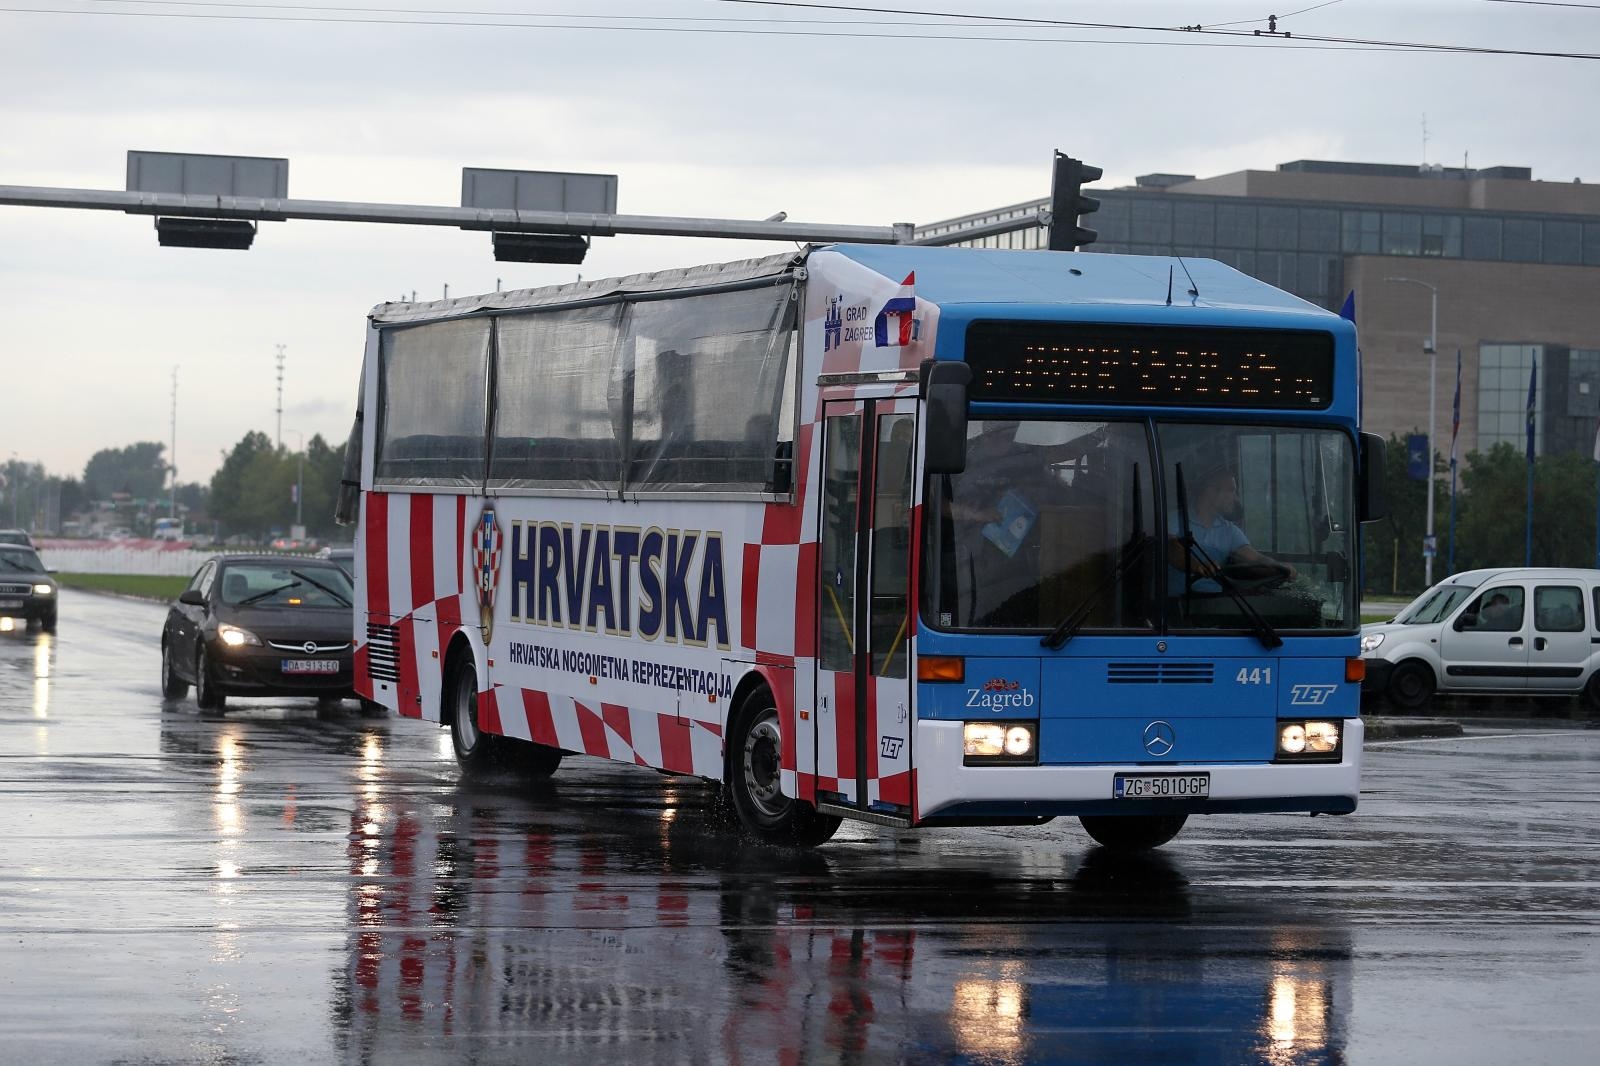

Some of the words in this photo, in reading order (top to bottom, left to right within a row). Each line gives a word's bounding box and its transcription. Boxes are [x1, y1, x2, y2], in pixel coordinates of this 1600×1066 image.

[846, 307, 867, 321] GRAD
[844, 327, 874, 342] ZAGREB
[511, 519, 731, 651] HRVATSKA
[509, 641, 560, 671] HRVATSKA
[562, 650, 630, 682] NOGOMETNA
[632, 662, 732, 700] REPREZENTACIJA
[1236, 667, 1271, 685] 441
[966, 687, 1034, 712] Zagreb
[1291, 684, 1338, 705] ZET
[880, 735, 904, 760] ZET
[1125, 779, 1142, 795] ZG
